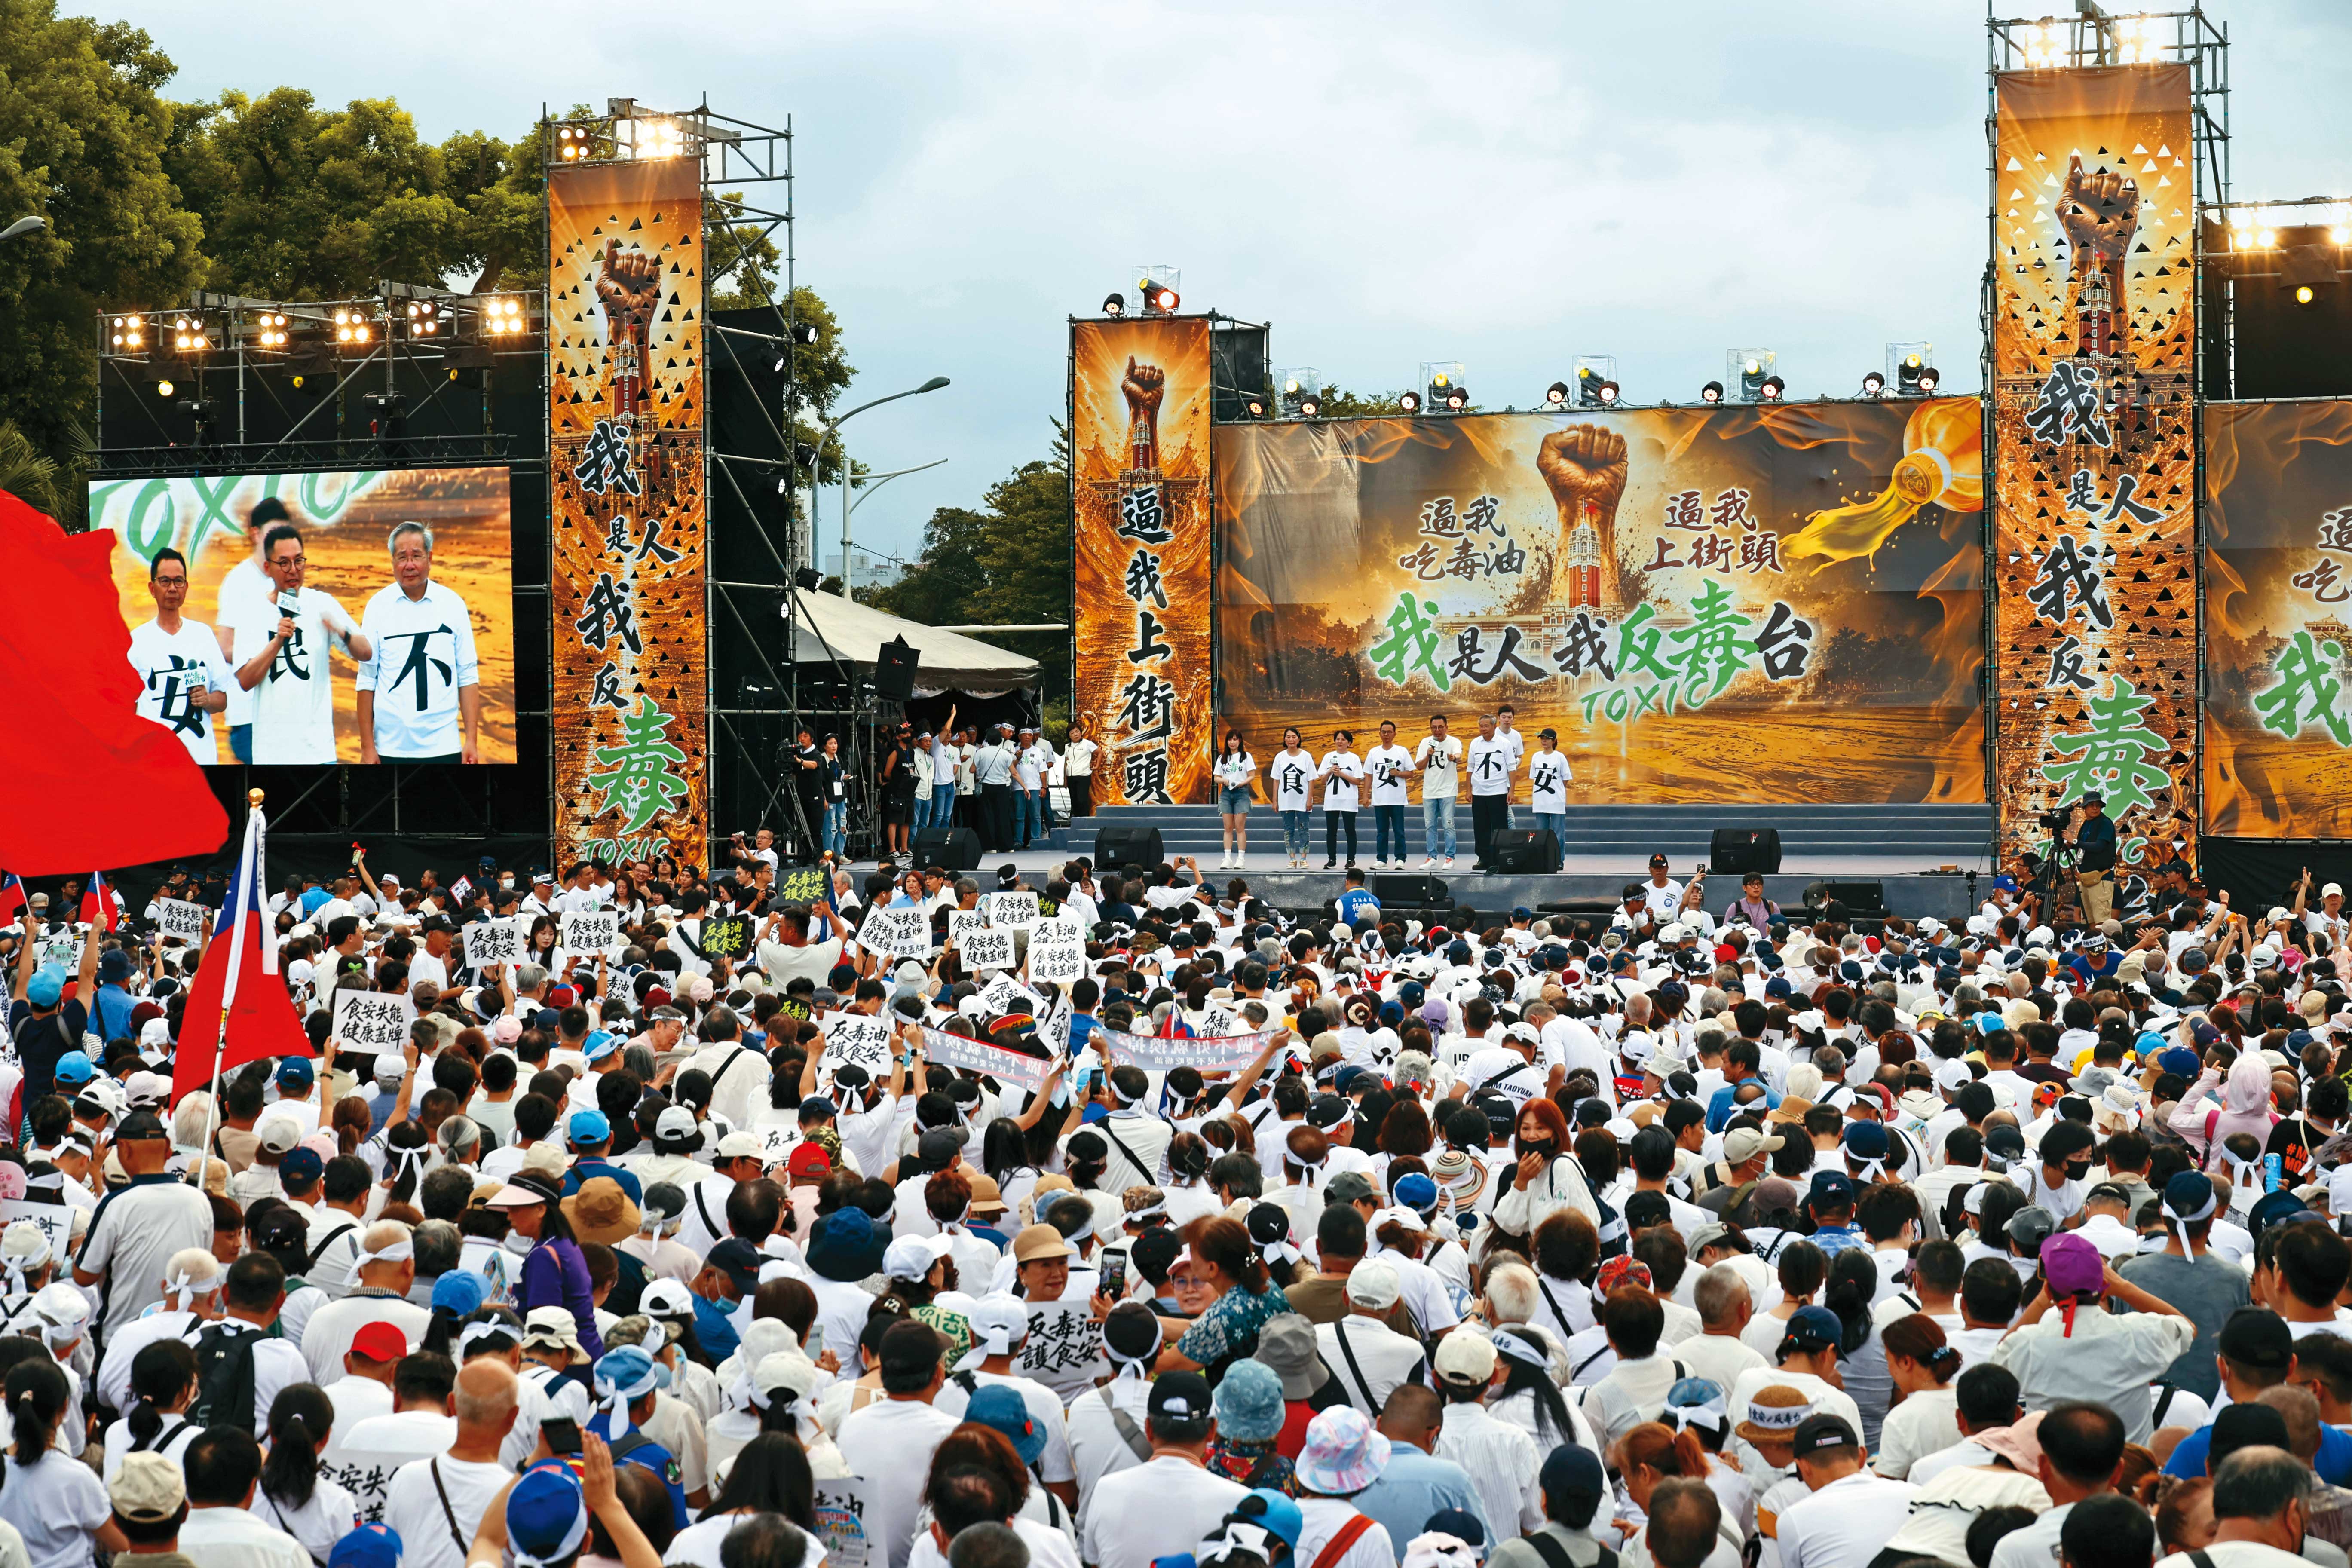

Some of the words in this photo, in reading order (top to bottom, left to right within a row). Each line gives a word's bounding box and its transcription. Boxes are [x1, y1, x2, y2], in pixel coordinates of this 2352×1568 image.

[1420, 496, 1506, 538] 逼我
[1665, 488, 1757, 531] 逼我
[1399, 537, 1526, 581] 吃毒油
[1643, 533, 1783, 573] 上街頭
[1115, 487, 1174, 804] 逼我上街頭
[384, 623, 453, 712] 不
[147, 655, 205, 739] 安
[1579, 677, 1711, 723] TOXIC
[1375, 757, 1400, 788] 安
[1479, 749, 1501, 780] 不
[1282, 763, 1304, 795] 食
[1534, 763, 1557, 794] 安
[784, 871, 824, 890] 反毒油
[164, 903, 201, 922] 食安失能
[996, 895, 1034, 911] 食安失能
[164, 919, 202, 939] 健康蓋牌
[569, 917, 613, 934] 食安失能
[885, 913, 923, 926] 安失能
[995, 909, 1036, 925] 健康蓋牌
[470, 928, 514, 945] 反毒油
[569, 933, 614, 951] 健康蓋牌
[704, 921, 743, 939] 反毒油
[470, 941, 518, 961] 護食安
[967, 934, 1008, 951] 食安失能
[966, 948, 1009, 965] 健康蓋牌
[1033, 948, 1078, 964] 食安失能
[1034, 964, 1079, 978] 健康蓋牌
[343, 997, 404, 1024] 食安失能
[340, 1021, 404, 1050] 健康蓋牌
[826, 1020, 888, 1043] 反毒油
[826, 1040, 888, 1065] 護食安
[1504, 1084, 1533, 1098] TAOYUAN
[1028, 1309, 1102, 1341] 反毒油
[1017, 1336, 1102, 1374] 護食安
